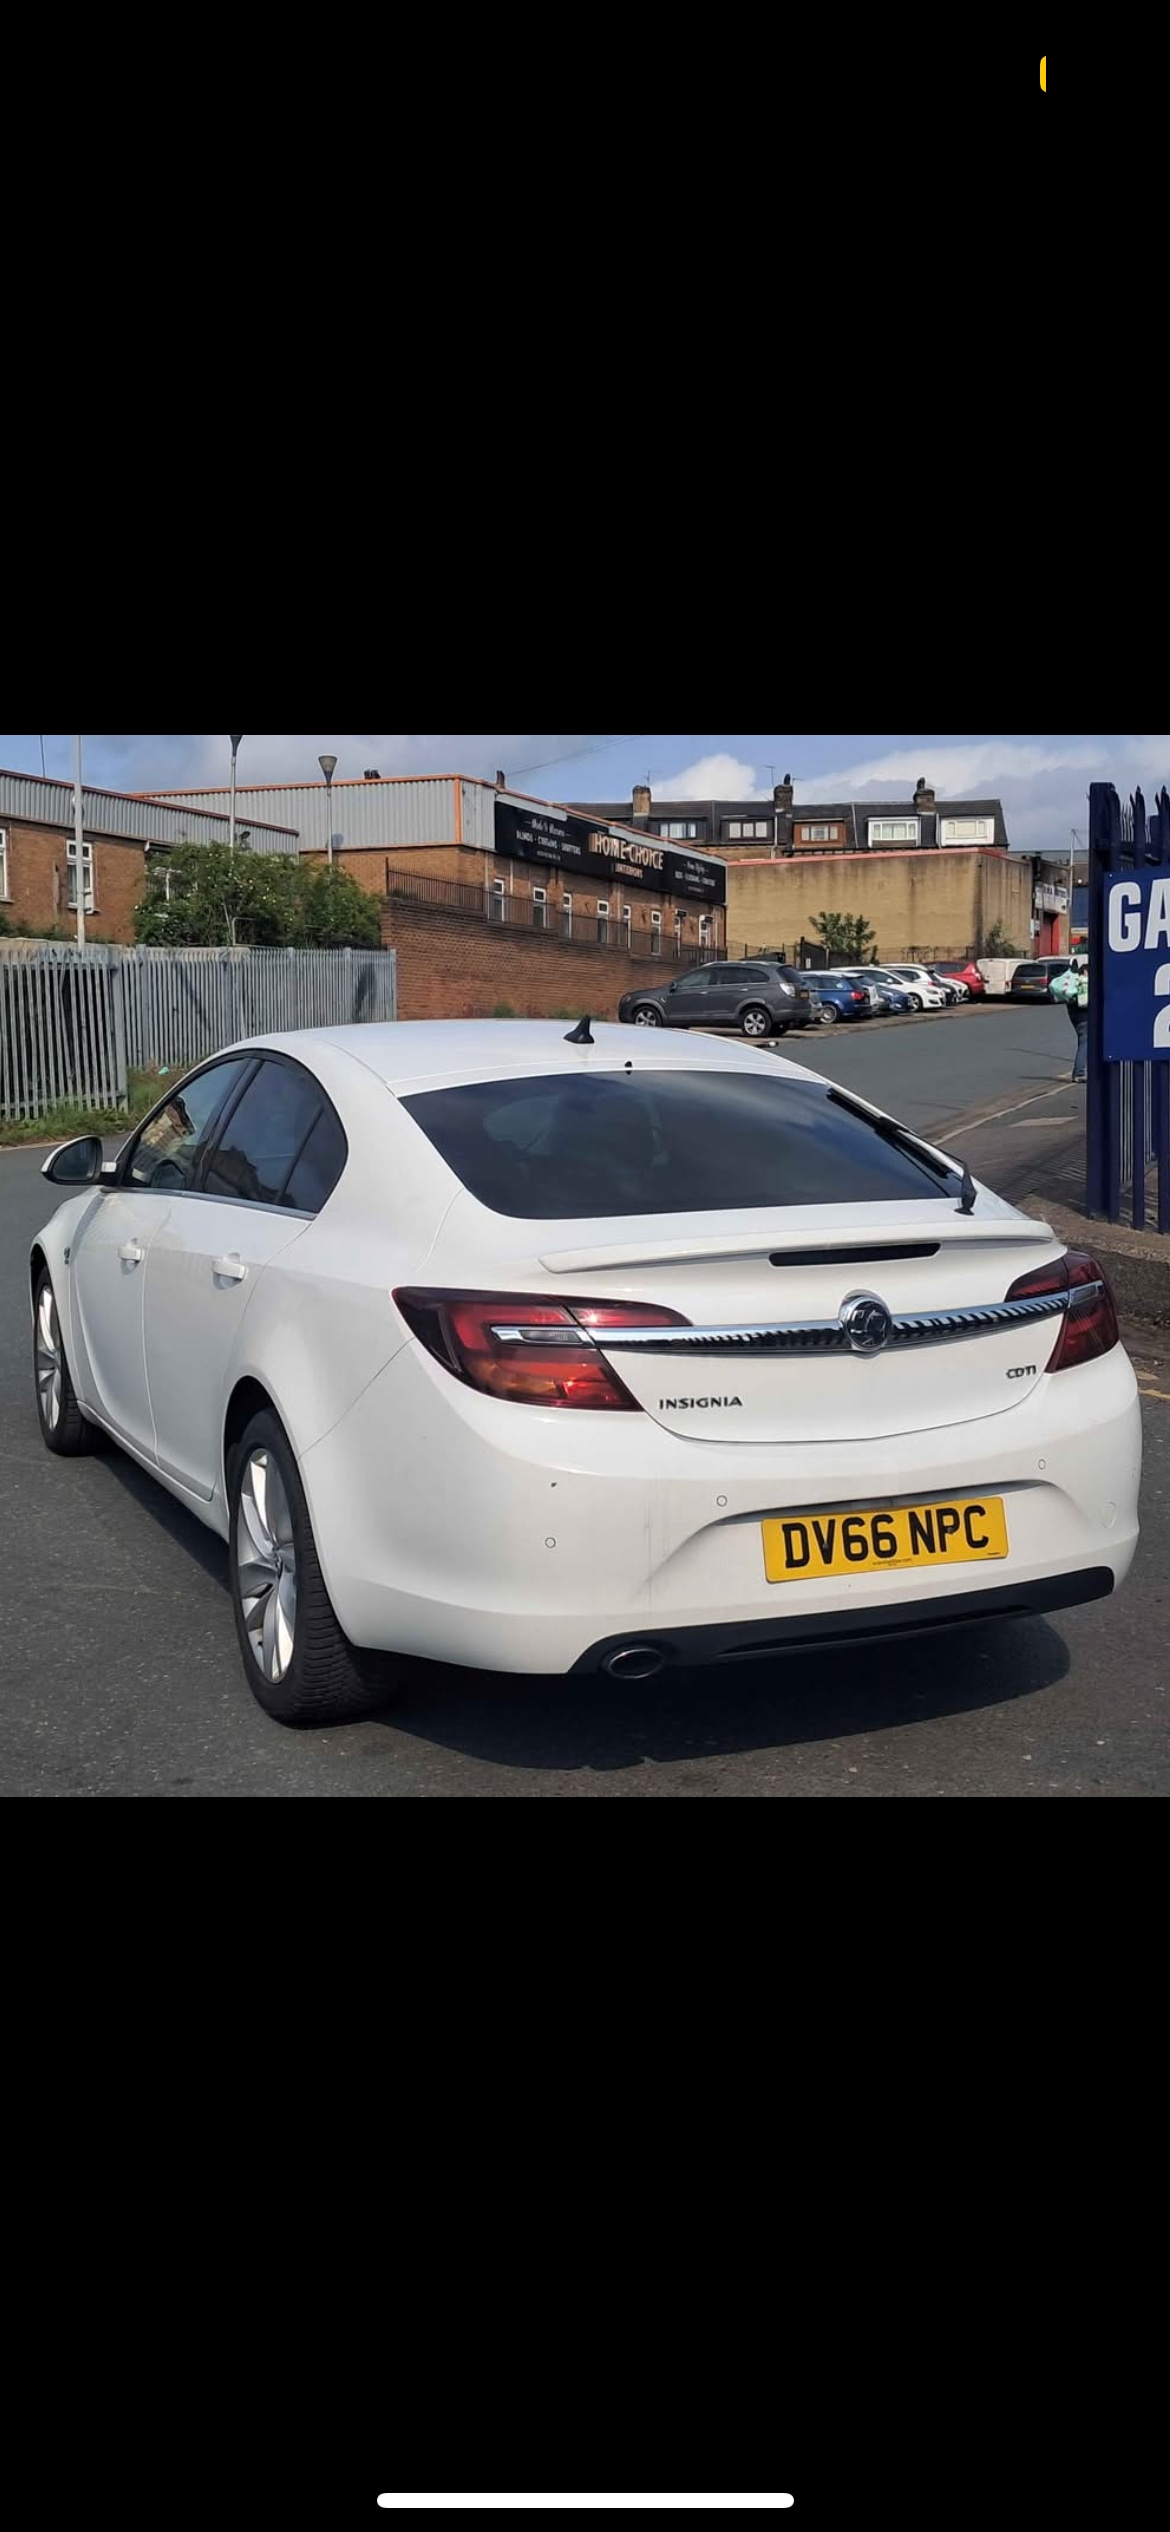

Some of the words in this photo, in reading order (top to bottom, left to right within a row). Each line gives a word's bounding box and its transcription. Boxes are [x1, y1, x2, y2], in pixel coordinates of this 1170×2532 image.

[659, 1396, 743, 1410] INSIGNIA
[781, 1514, 897, 1569] DV66
[908, 1505, 989, 1555] NPC
